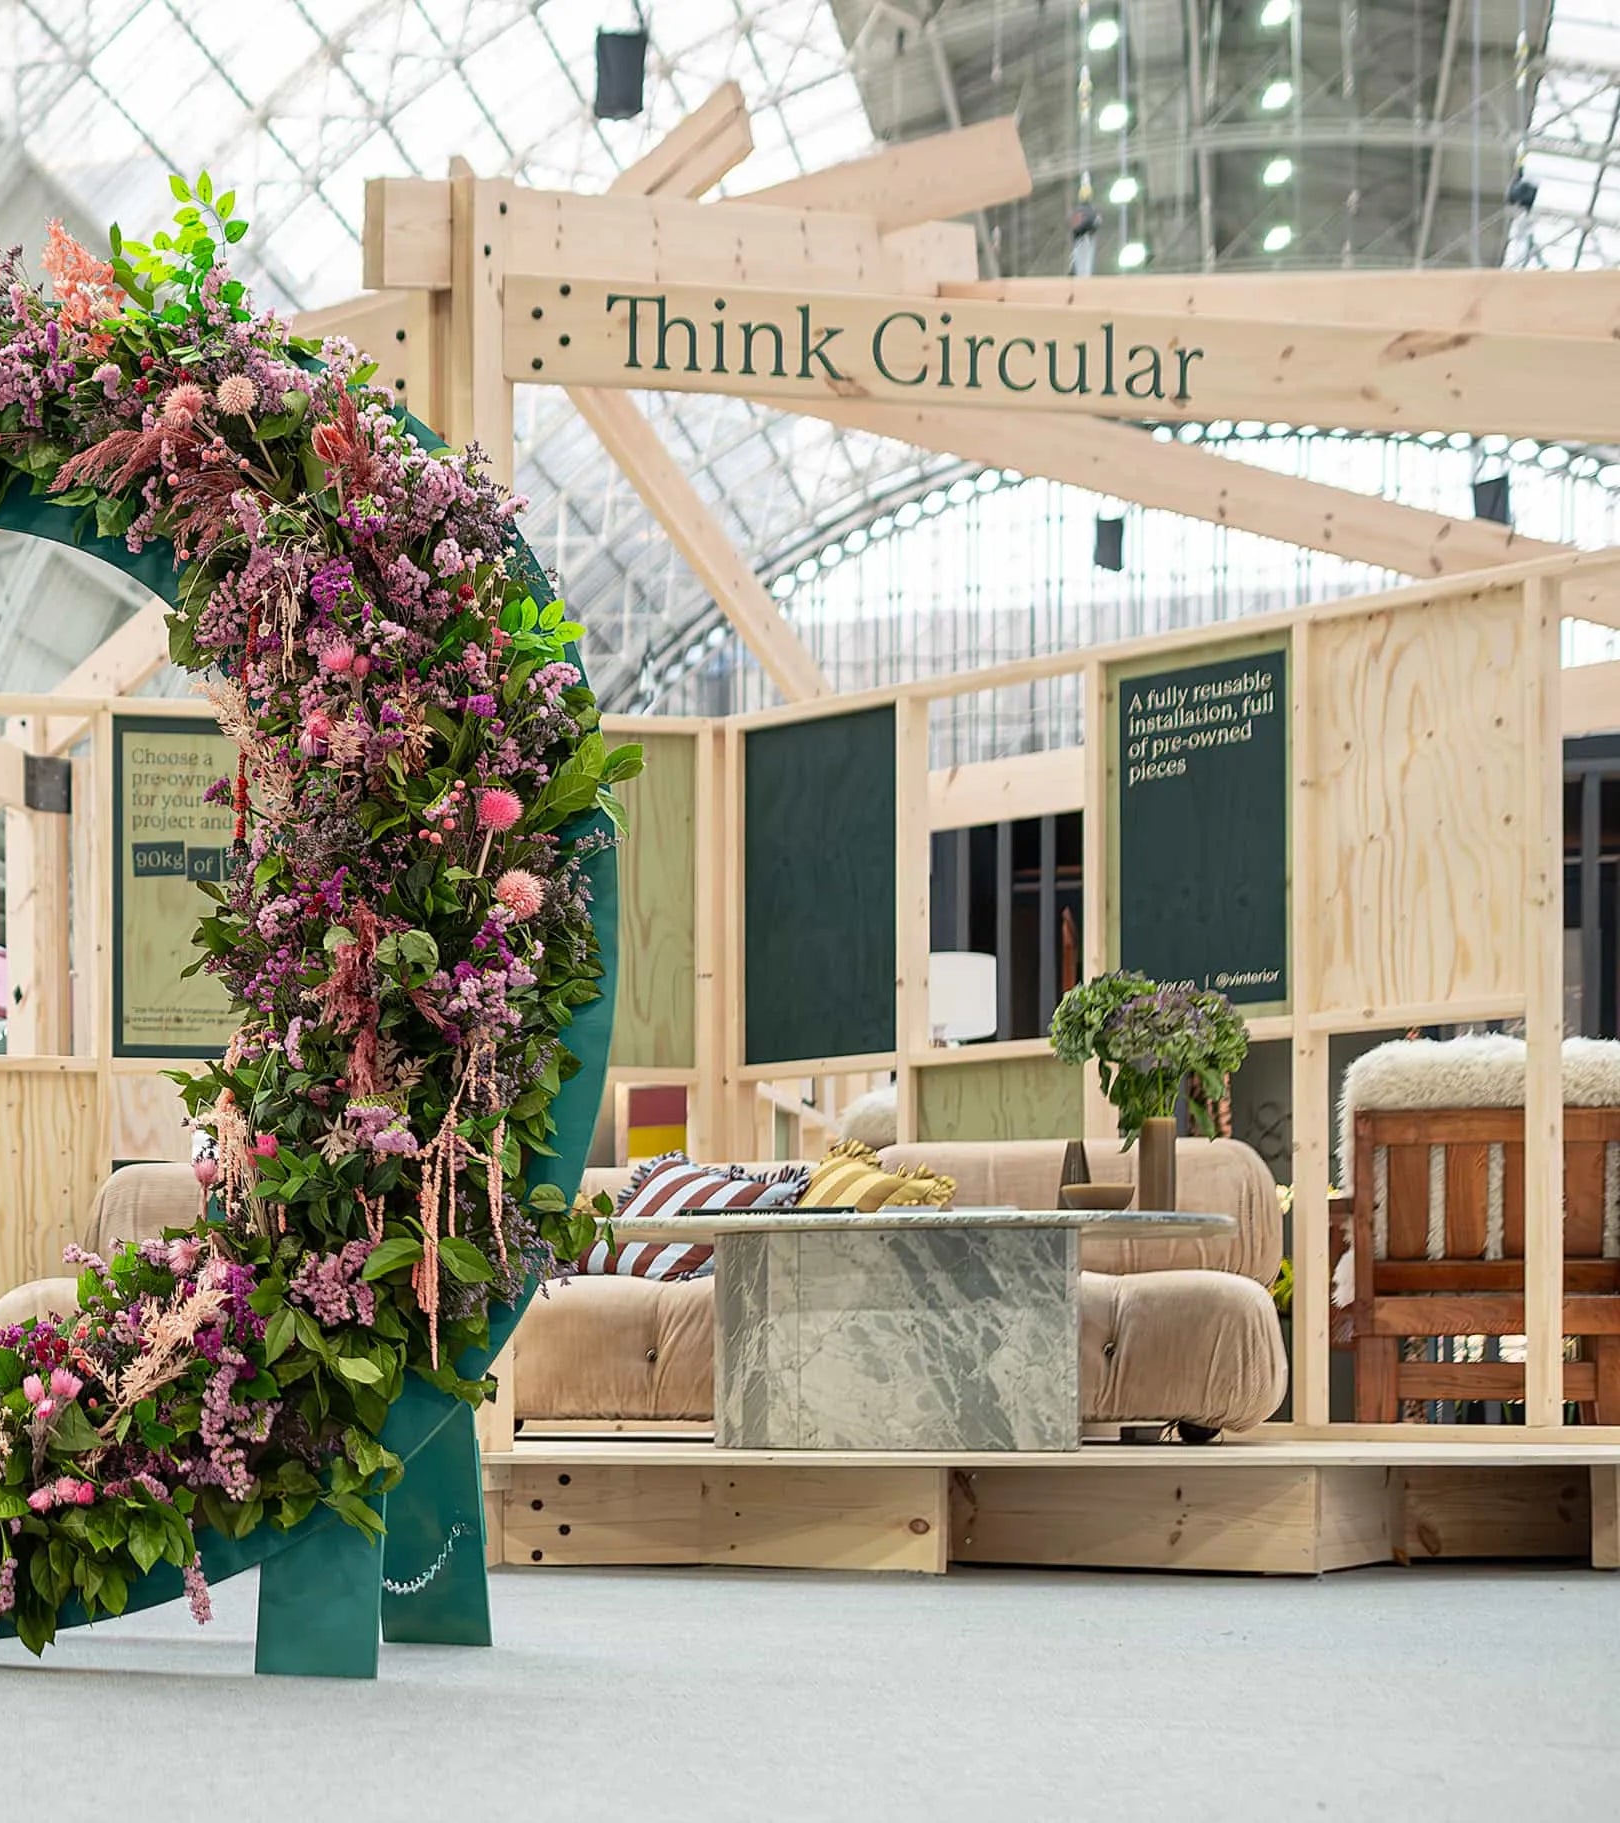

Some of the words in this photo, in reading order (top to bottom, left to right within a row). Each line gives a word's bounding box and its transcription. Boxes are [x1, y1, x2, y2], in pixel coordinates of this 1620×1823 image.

[606, 293, 846, 381] Think
[871, 311, 1205, 401] Circular
[1128, 693, 1143, 714] A
[1147, 685, 1189, 711] fully
[1192, 669, 1273, 702] reusable
[1129, 702, 1239, 737] installation,
[1242, 691, 1275, 718] full
[1128, 736, 1148, 760] of
[1151, 718, 1253, 760] pre-owned
[131, 748, 199, 767] Choose
[203, 752, 213, 767] a
[1128, 757, 1187, 787] pieces
[131, 790, 158, 807] for
[162, 794, 202, 811] your
[131, 812, 196, 832] project
[200, 812, 233, 830] and
[135, 850, 184, 870] 90kg
[193, 856, 215, 874] of
[1215, 967, 1280, 989] @vinterior
